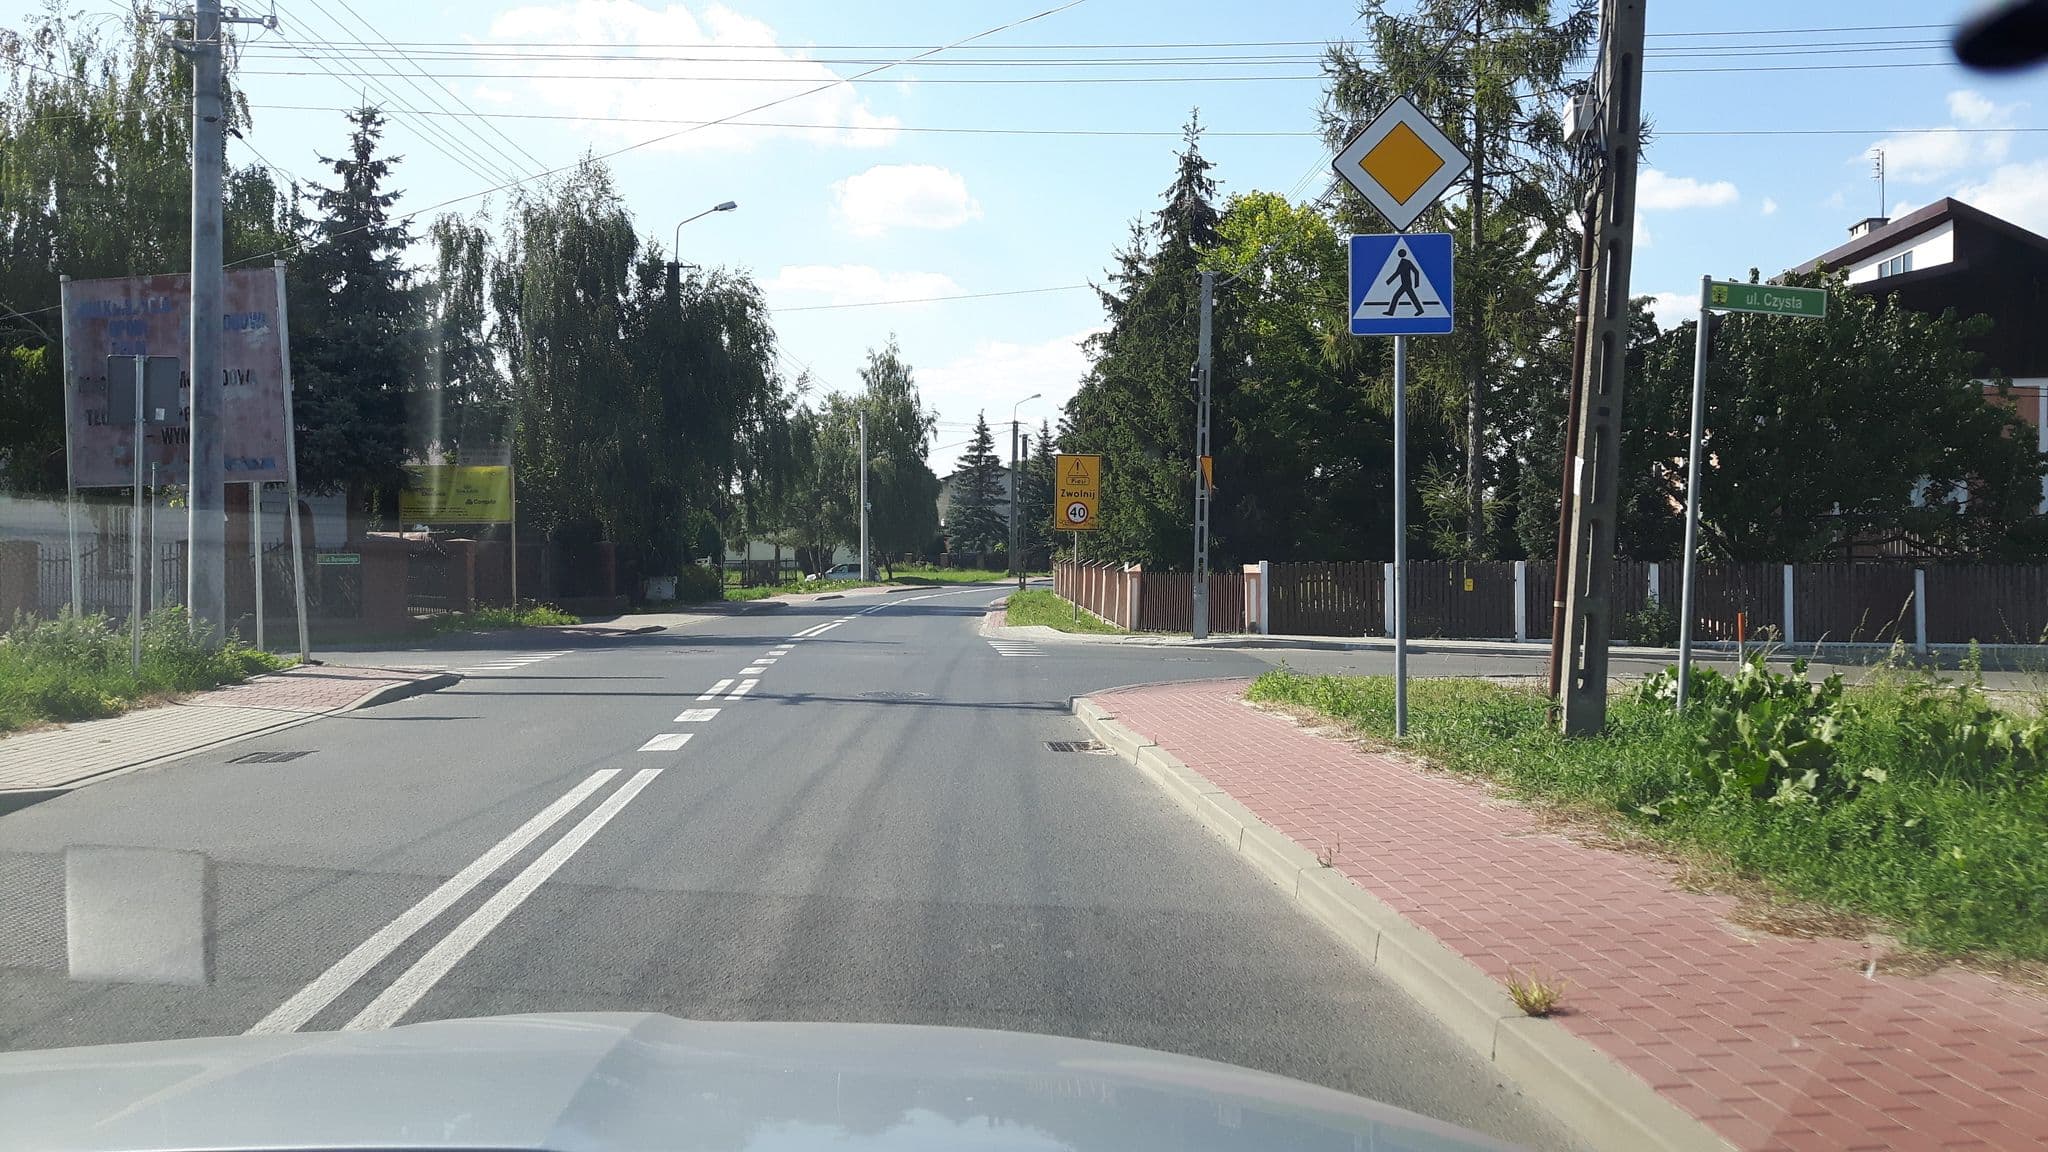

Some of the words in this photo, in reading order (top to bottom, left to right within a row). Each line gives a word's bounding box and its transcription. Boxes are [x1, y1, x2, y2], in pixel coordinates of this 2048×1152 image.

[1746, 292, 1760, 306] ul.
[1763, 292, 1803, 311] Czysta
[1060, 488, 1096, 500] Zwolnij
[1069, 506, 1086, 519] 40
